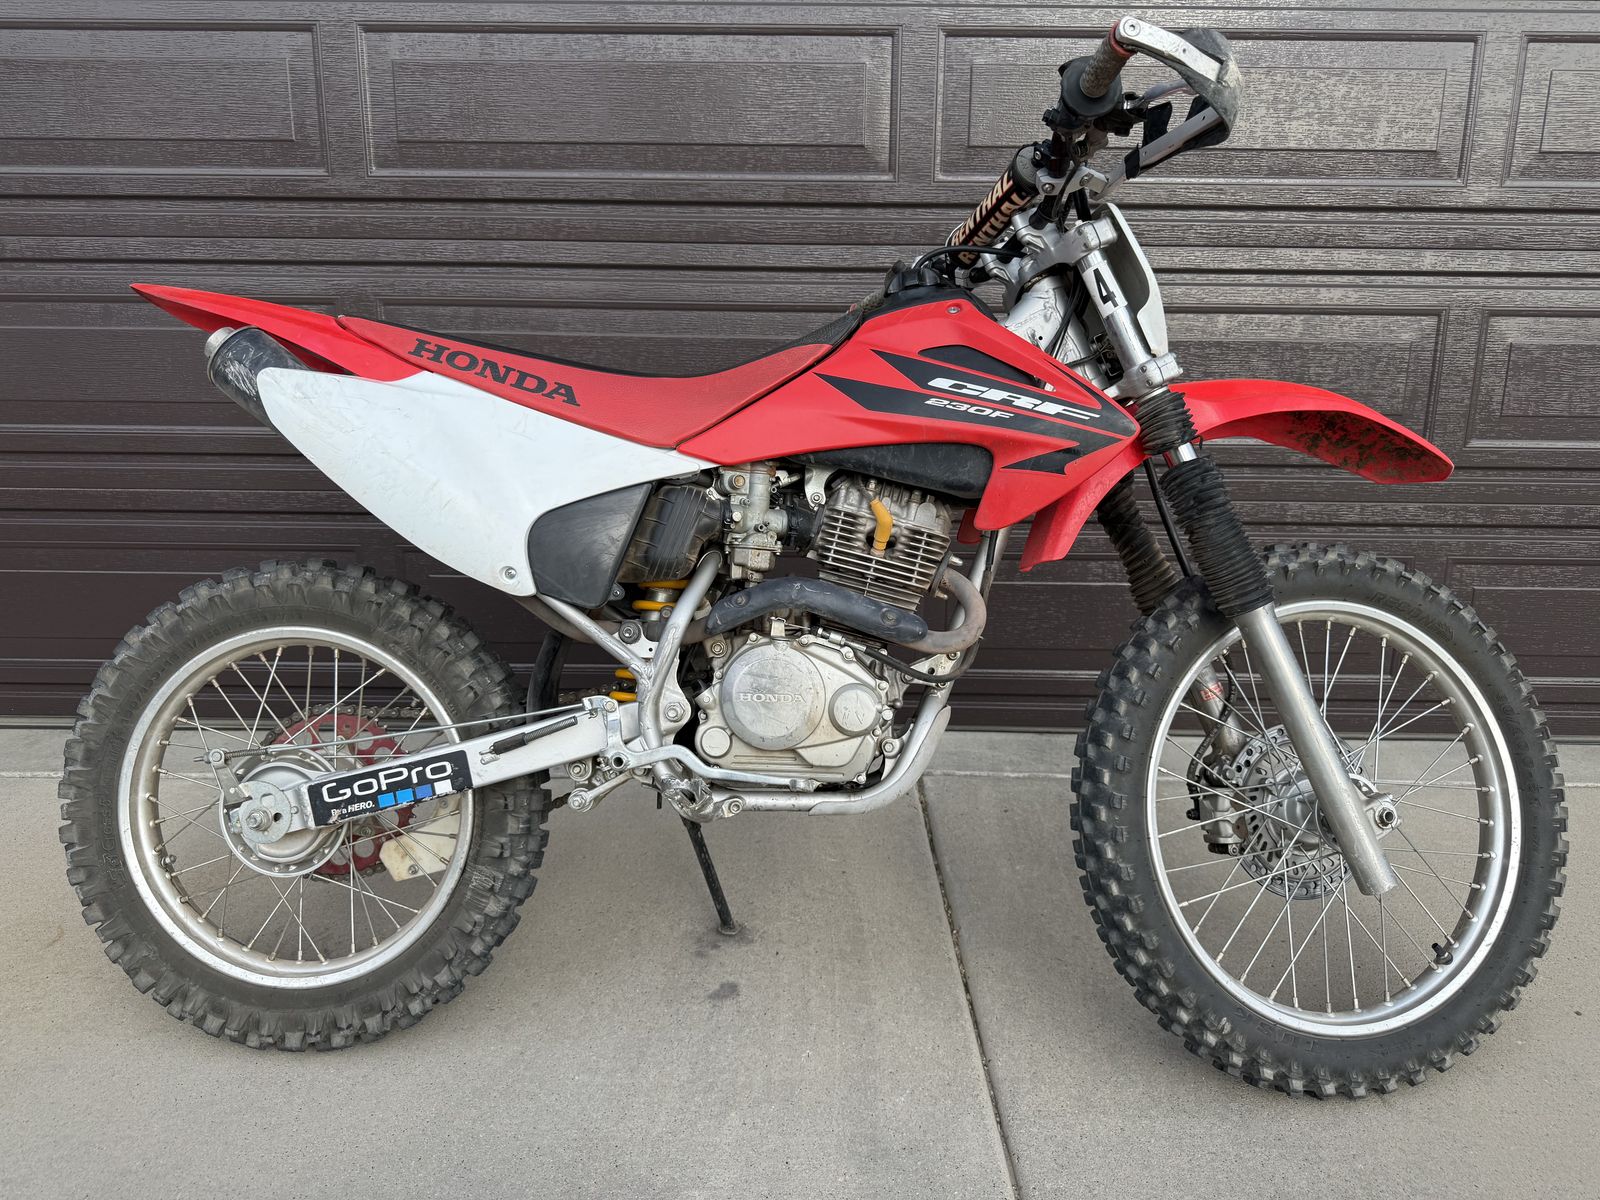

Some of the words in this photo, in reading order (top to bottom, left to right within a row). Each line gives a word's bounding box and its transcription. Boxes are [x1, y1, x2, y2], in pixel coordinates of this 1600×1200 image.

[951, 170, 1014, 247] RENTHAL
[957, 191, 1032, 265] RNTHAL
[1093, 267, 1119, 308] 4
[407, 338, 581, 407] HONDA
[924, 398, 1015, 419] 230F
[927, 377, 1101, 420] CRF
[736, 691, 807, 704] HONDA
[321, 761, 452, 802] GoPro
[347, 800, 375, 814] HERO.
